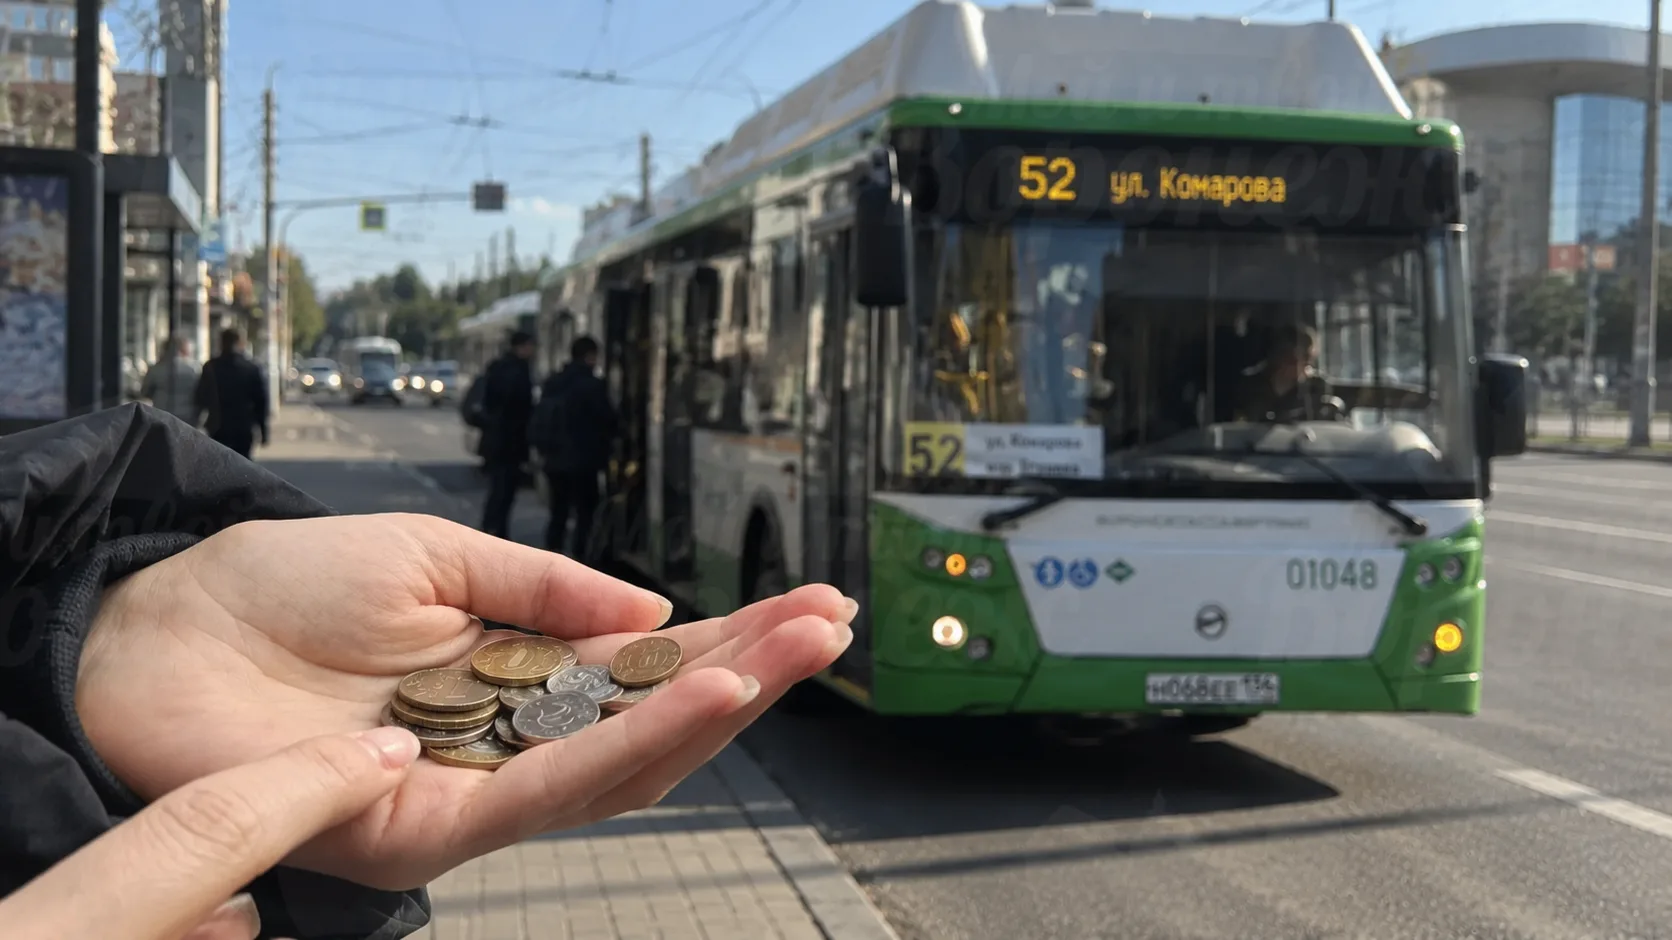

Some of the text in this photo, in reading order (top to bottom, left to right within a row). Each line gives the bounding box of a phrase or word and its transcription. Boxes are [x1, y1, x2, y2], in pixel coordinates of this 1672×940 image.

[1019, 156, 1076, 200] 52
[1110, 166, 1286, 207] ул. Комарова
[911, 433, 964, 474] 52
[1286, 558, 1379, 590] 01048
